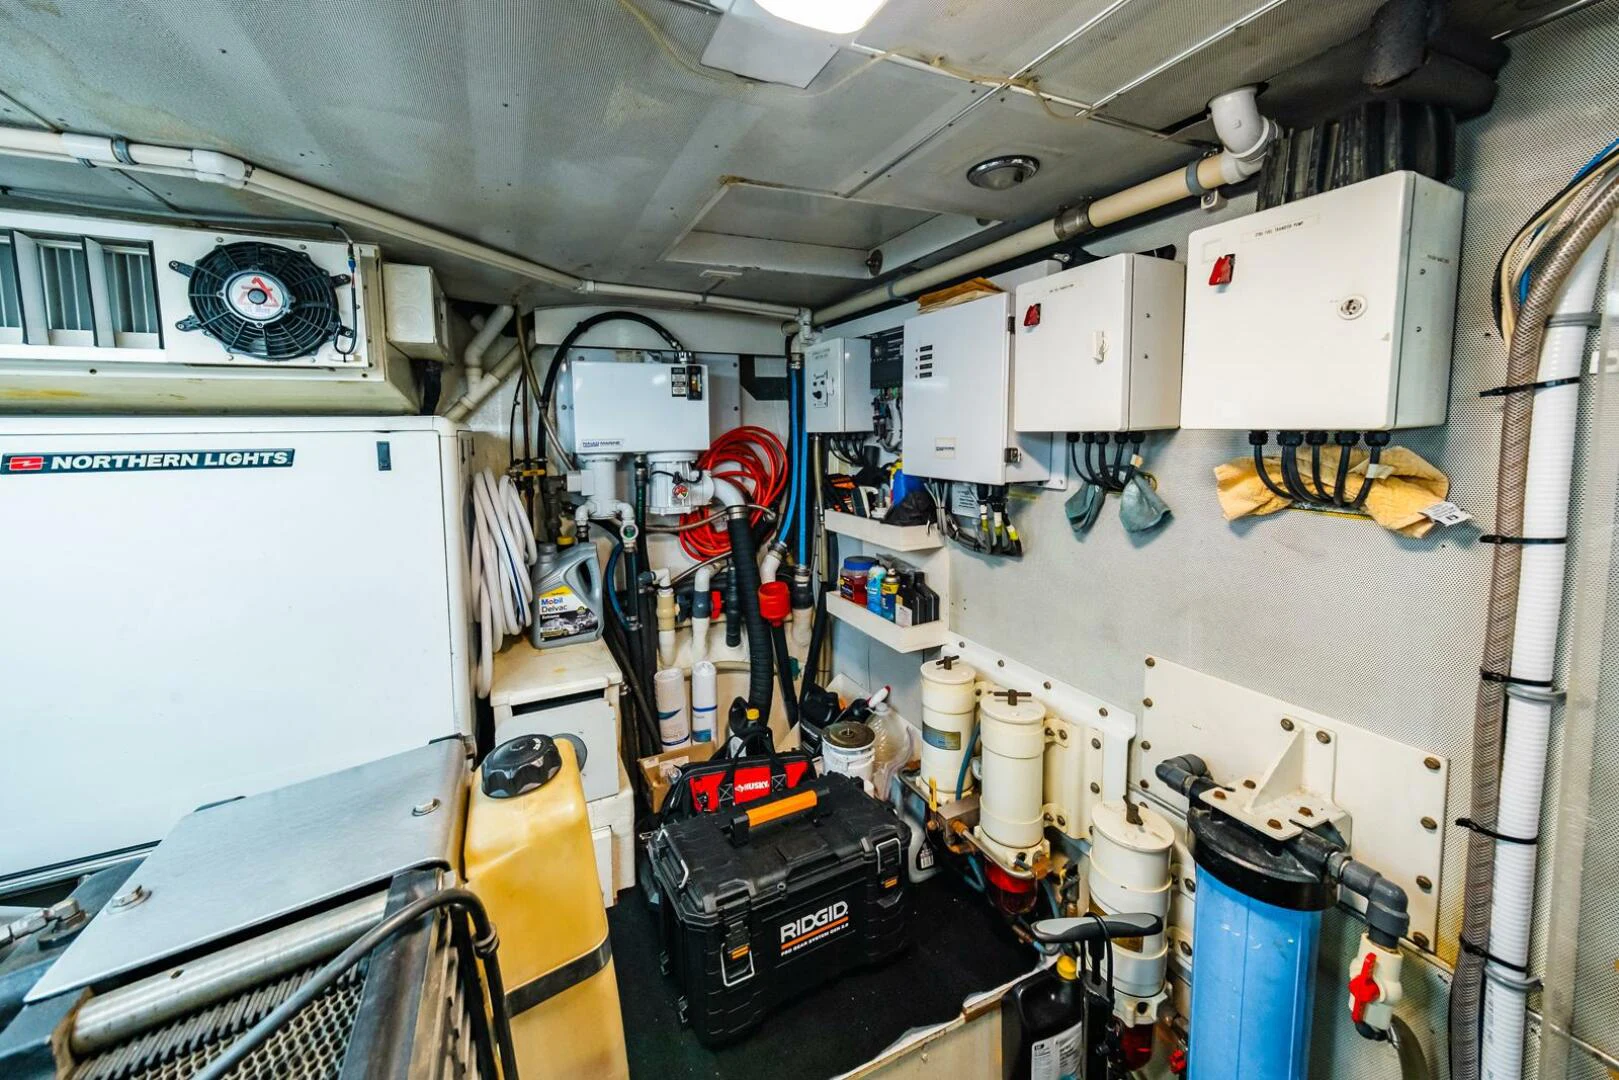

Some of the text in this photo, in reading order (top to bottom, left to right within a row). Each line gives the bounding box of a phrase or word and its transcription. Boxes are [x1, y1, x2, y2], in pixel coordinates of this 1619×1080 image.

[51, 451, 288, 470] NORTHERN LIGHTS
[541, 597, 563, 605] Mobil
[541, 604, 567, 612] Delvac
[743, 780, 769, 791] HUSKY
[780, 900, 848, 944] RIDGID
[780, 948, 792, 957] PRO
[793, 941, 808, 951] GEAR
[809, 931, 829, 944] SYSTEM
[829, 926, 841, 934] GEN
